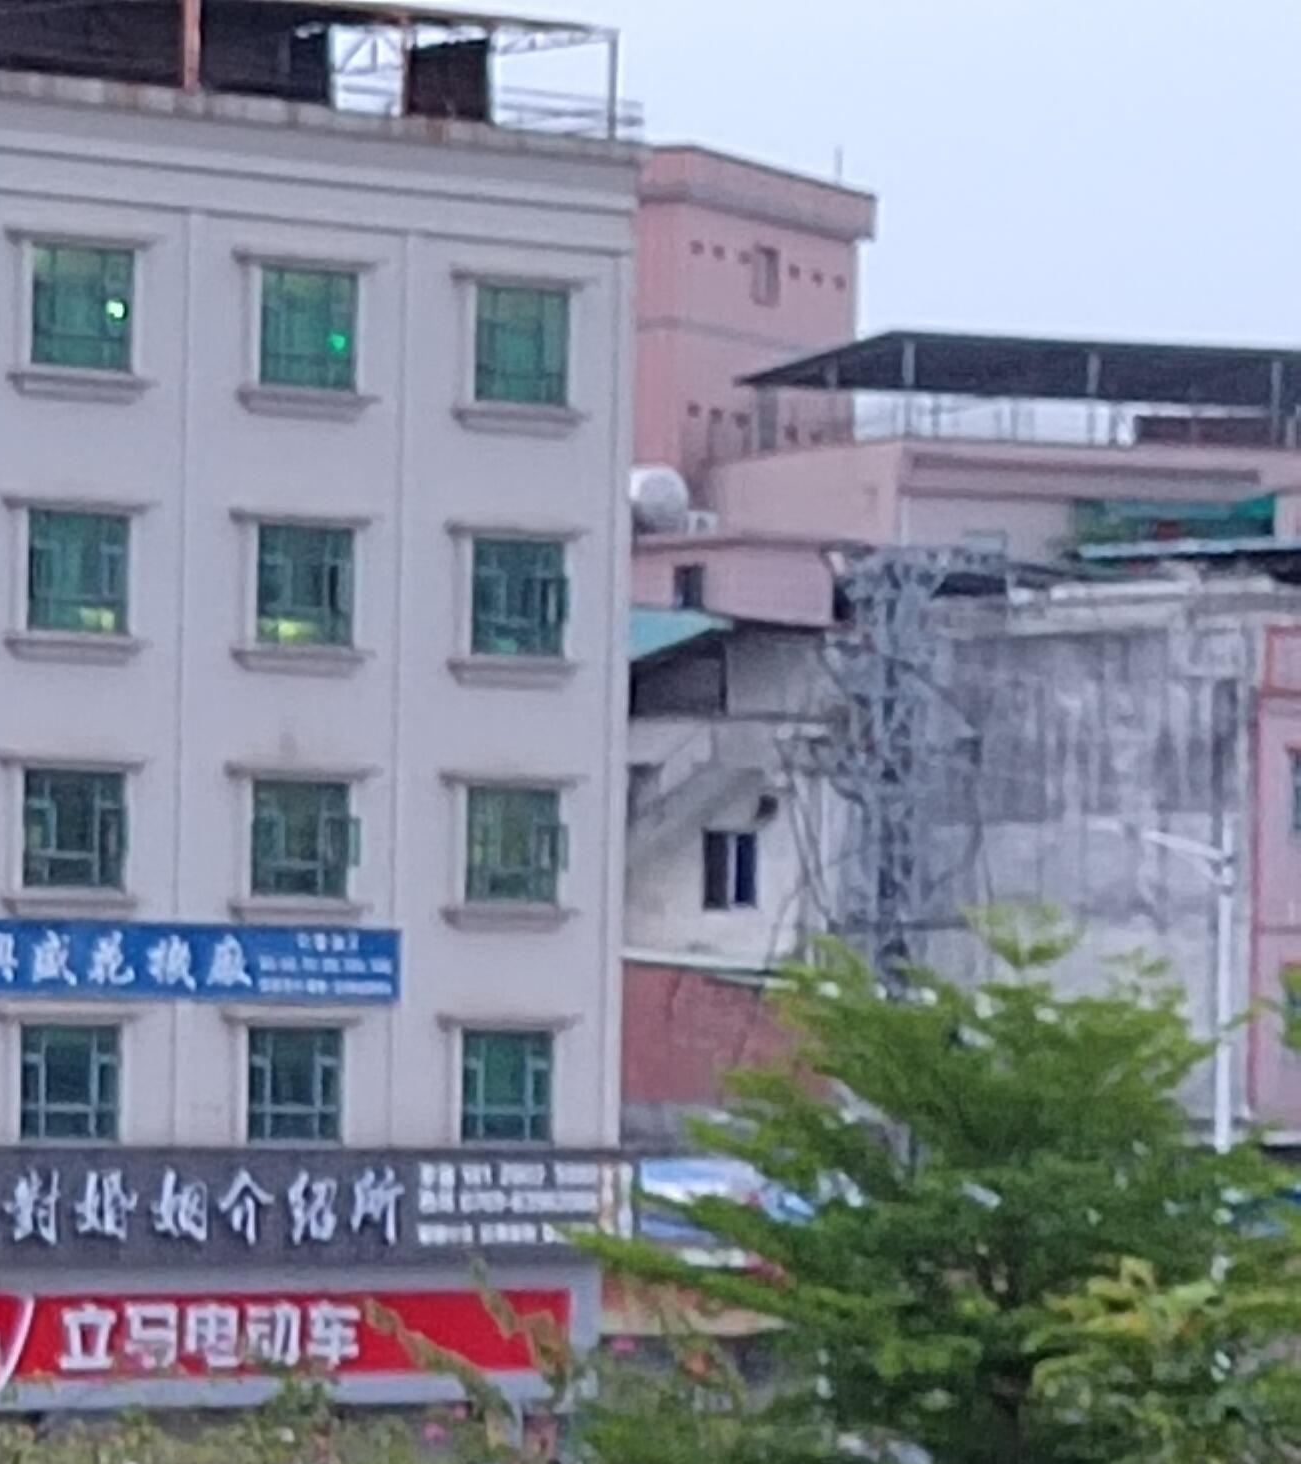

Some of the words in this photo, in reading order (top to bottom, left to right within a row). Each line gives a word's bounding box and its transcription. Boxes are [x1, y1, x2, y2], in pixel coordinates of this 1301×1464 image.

[59, 1301, 360, 1371] 立马电动车
